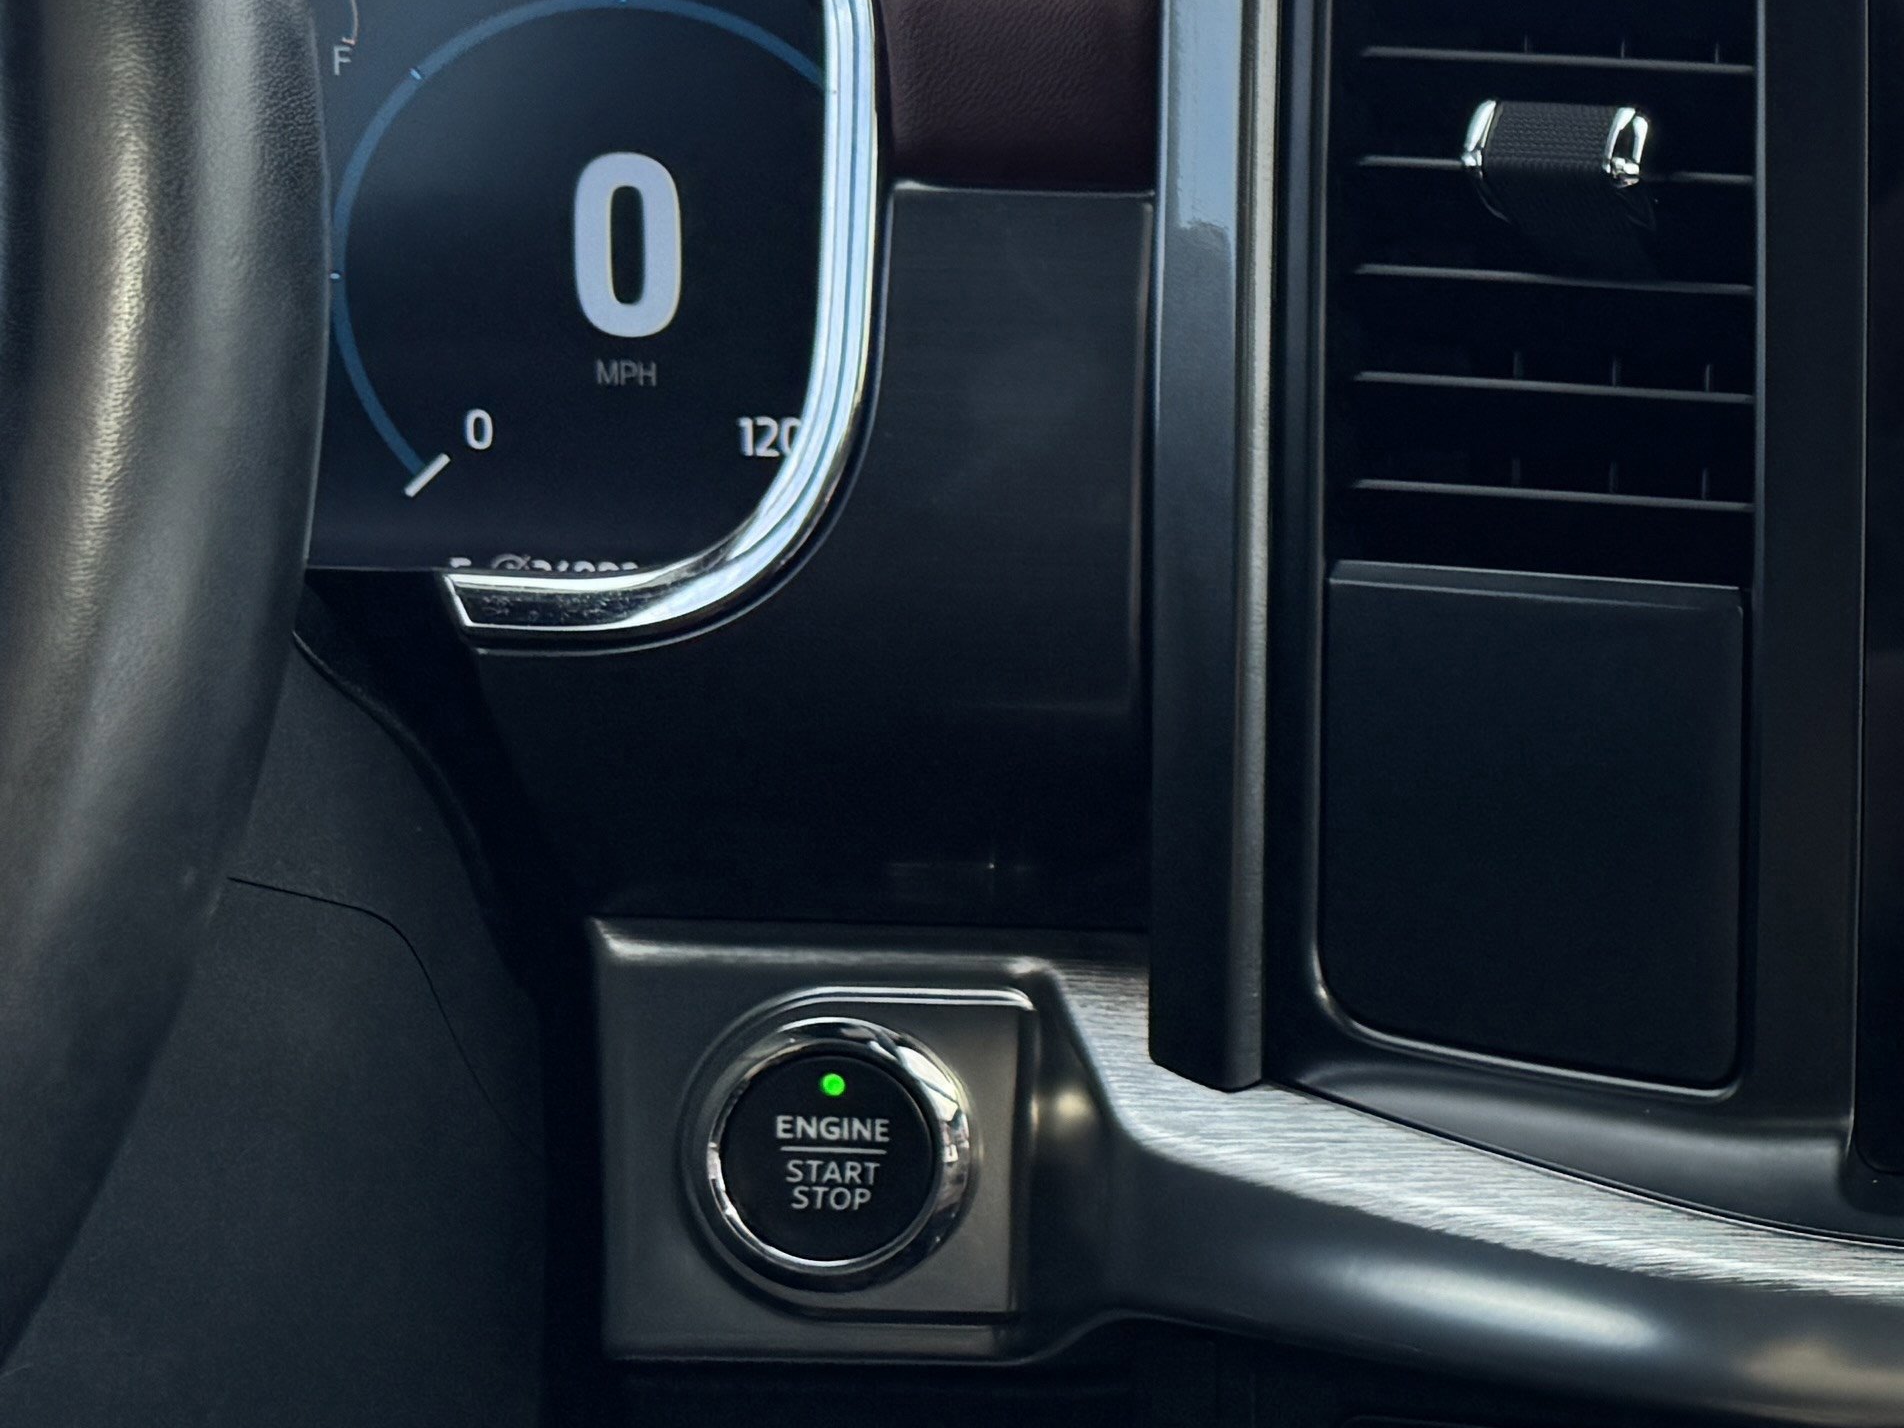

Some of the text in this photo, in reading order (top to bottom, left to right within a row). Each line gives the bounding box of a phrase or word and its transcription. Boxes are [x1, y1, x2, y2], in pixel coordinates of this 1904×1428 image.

[333, 46, 351, 75] F
[573, 151, 682, 338] 0
[597, 360, 656, 389] MPH
[466, 409, 492, 449] 0
[777, 1116, 889, 1141] ENGINE
[786, 1160, 879, 1184] START
[792, 1186, 870, 1210] STOP
